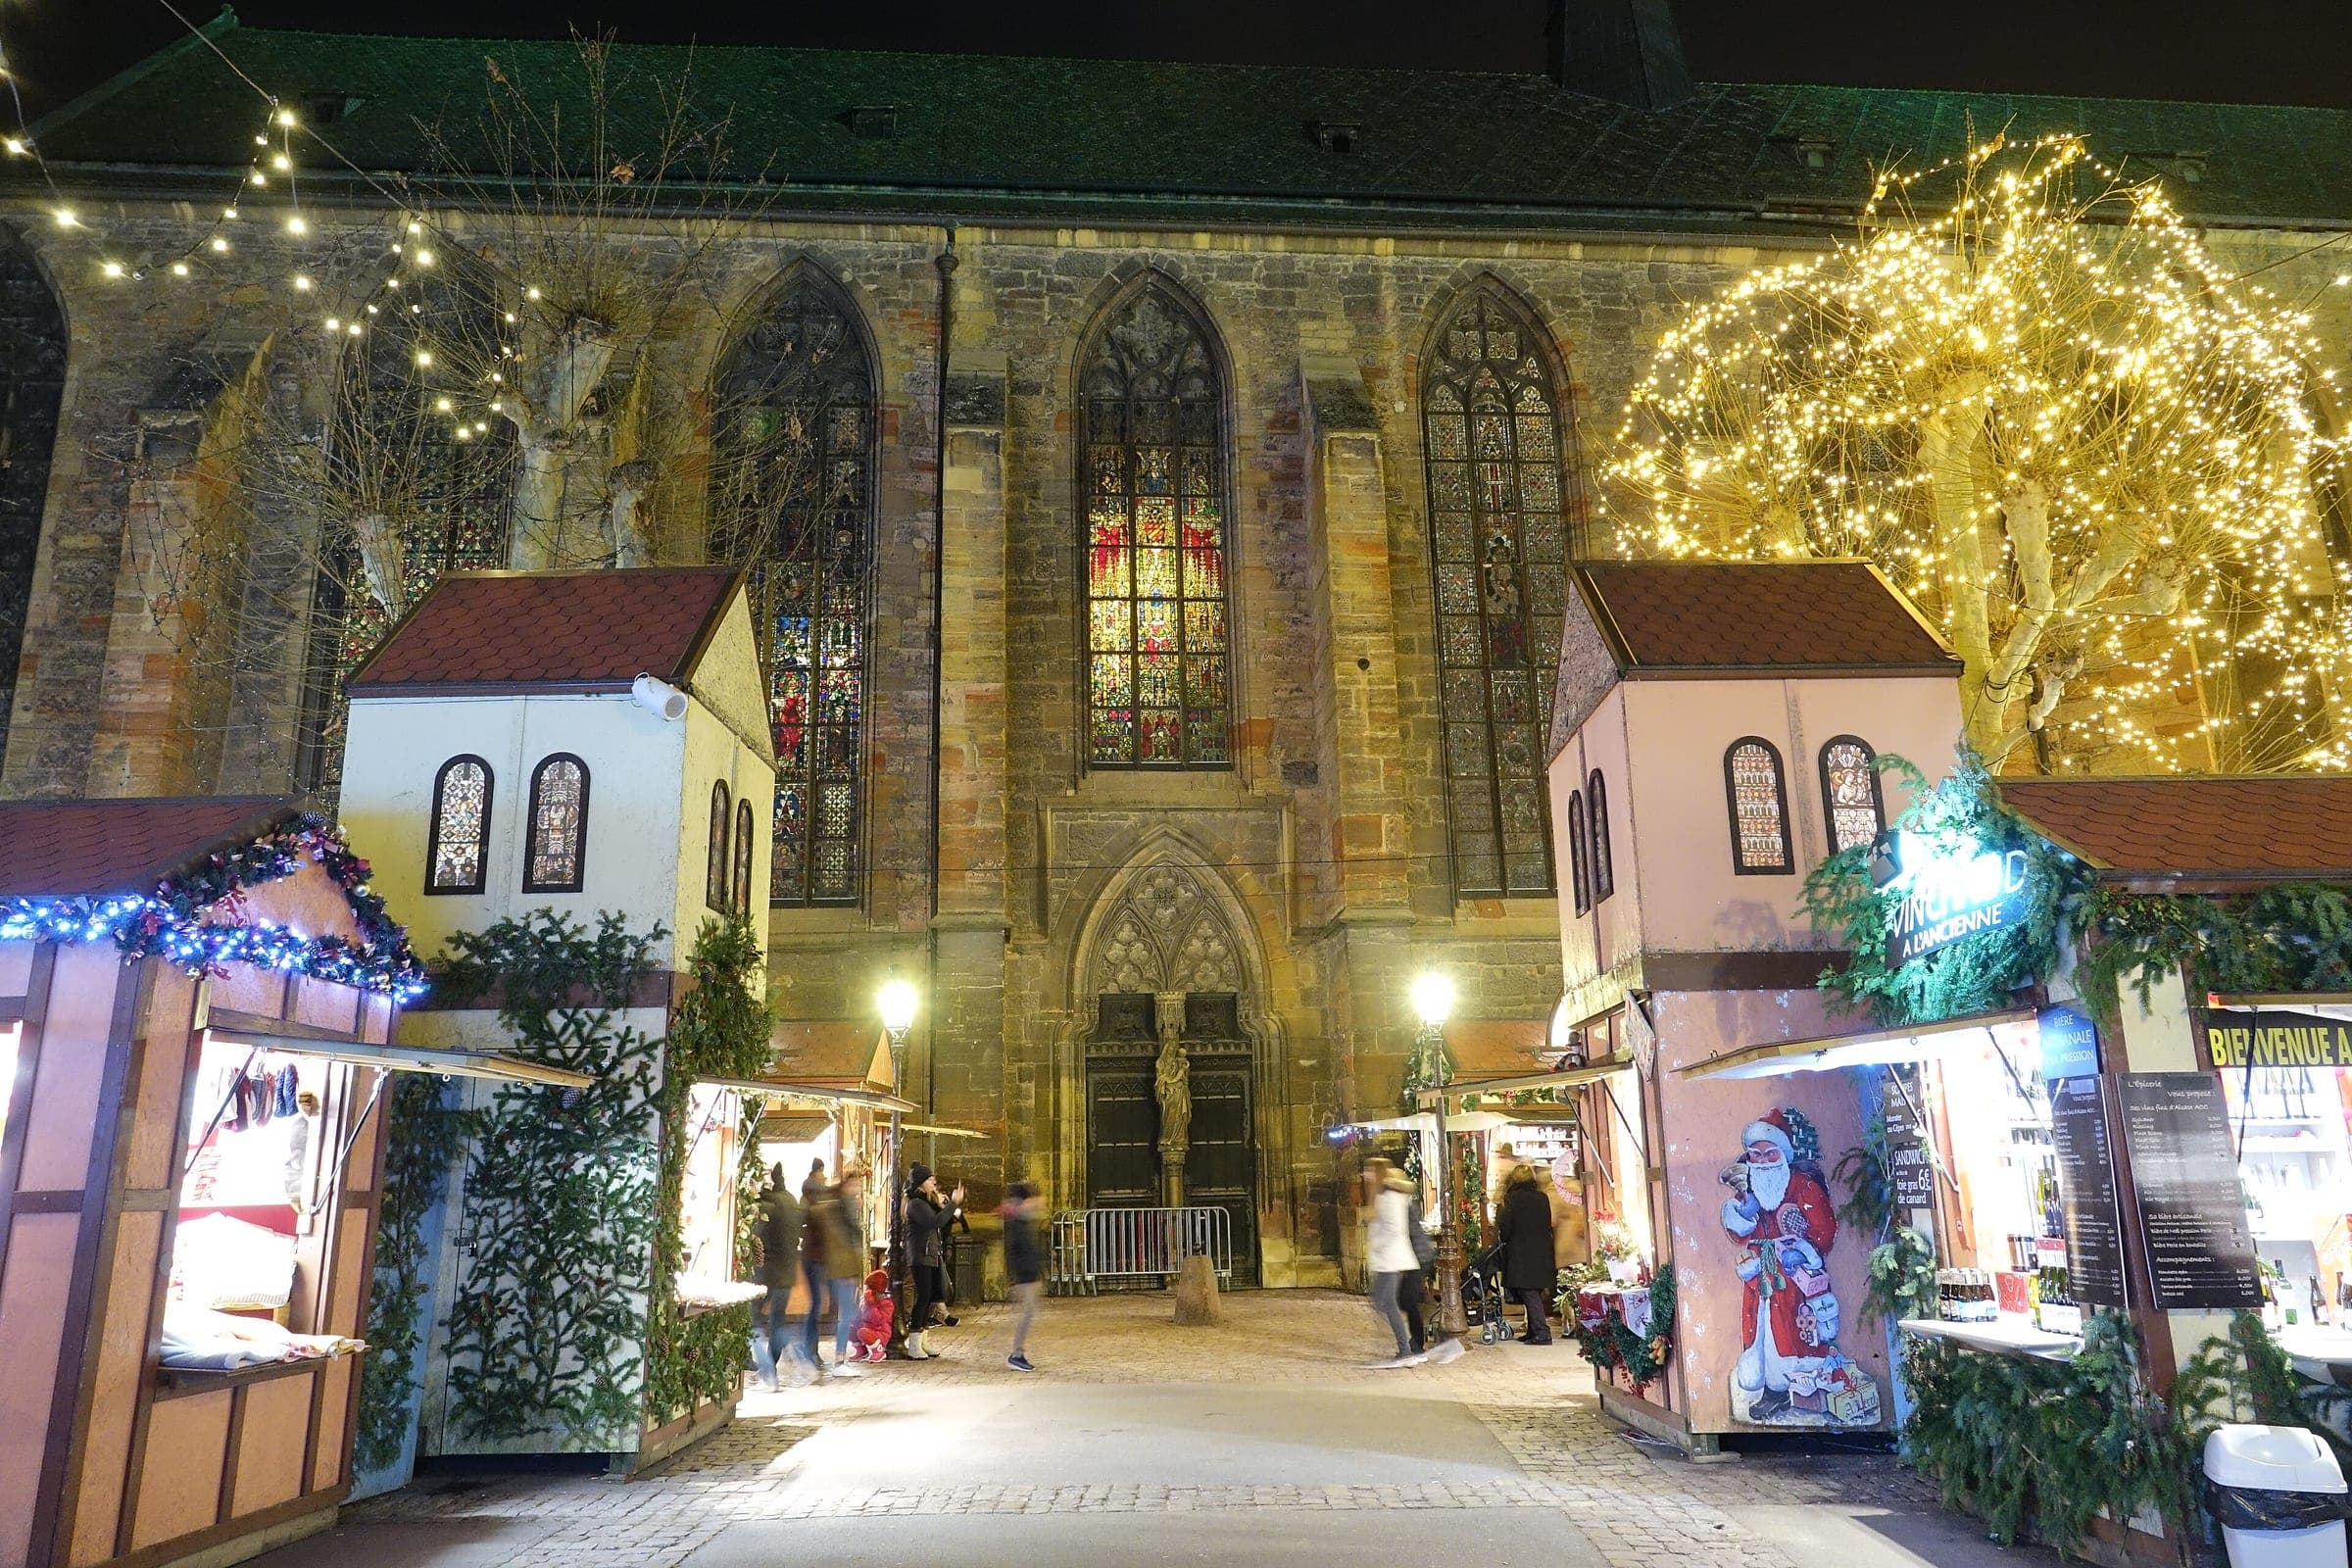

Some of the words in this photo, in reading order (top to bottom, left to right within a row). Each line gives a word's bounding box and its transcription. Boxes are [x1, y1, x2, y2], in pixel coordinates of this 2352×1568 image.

[1913, 903, 2002, 953] L'ANCIENNE
[2053, 1013, 2074, 1028] BIÈRE
[2208, 1027, 2334, 1066] BIENVENUE
[1896, 1178, 1907, 1191] foie
[1897, 1192, 1906, 1204] de
[1906, 1192, 1927, 1204] canard
